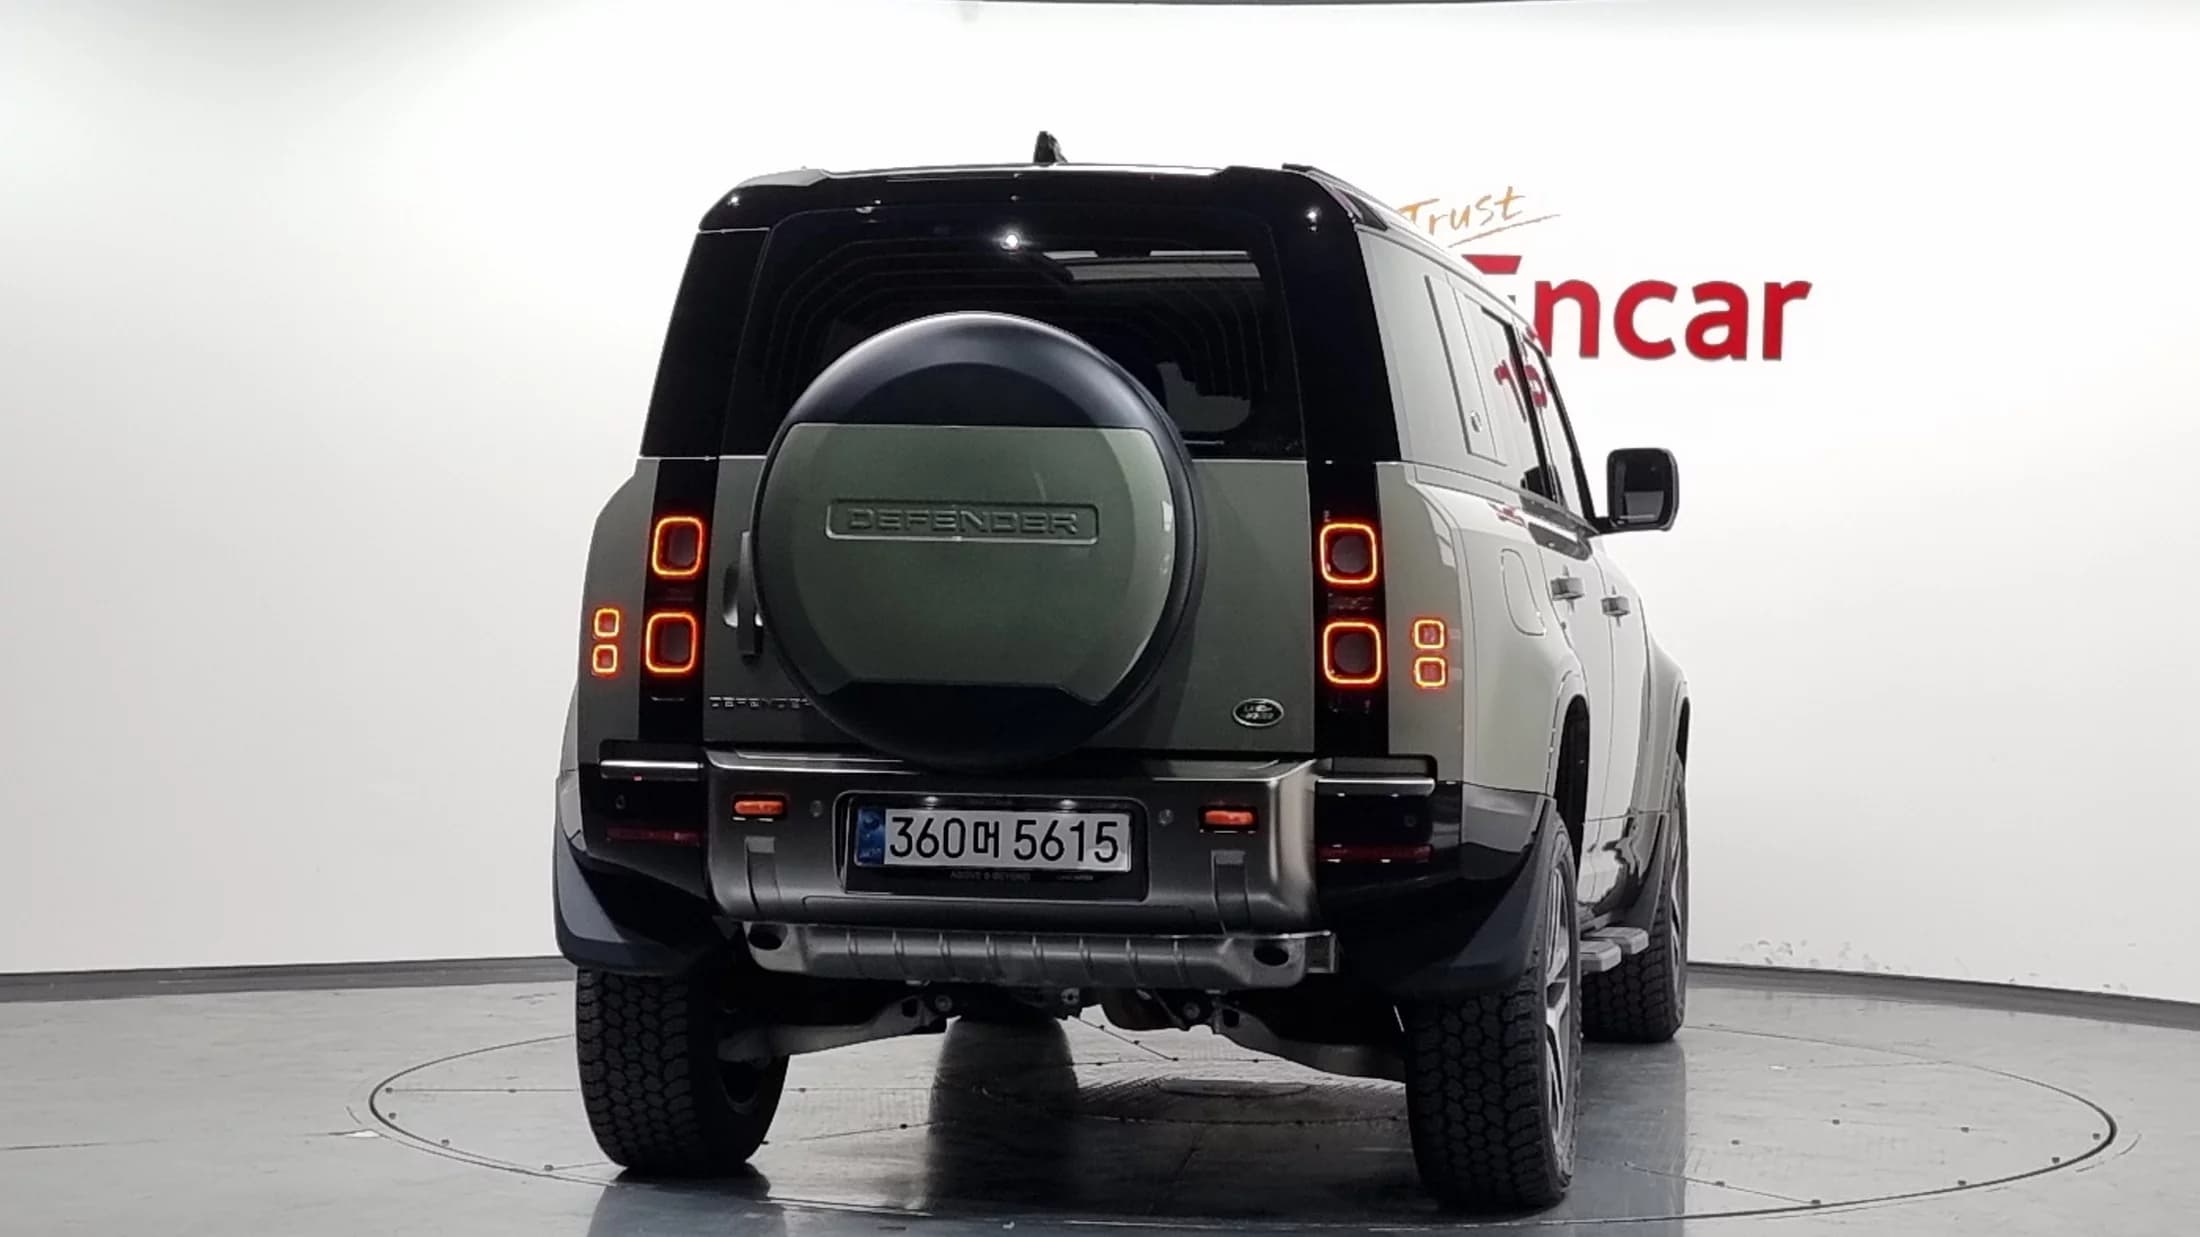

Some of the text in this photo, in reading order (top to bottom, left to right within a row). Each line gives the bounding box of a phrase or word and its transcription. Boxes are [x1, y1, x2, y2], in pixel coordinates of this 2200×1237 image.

[1398, 185, 1526, 236] Trust
[848, 507, 1079, 534] DEFENDER
[889, 815, 1120, 864] 360머 5615
